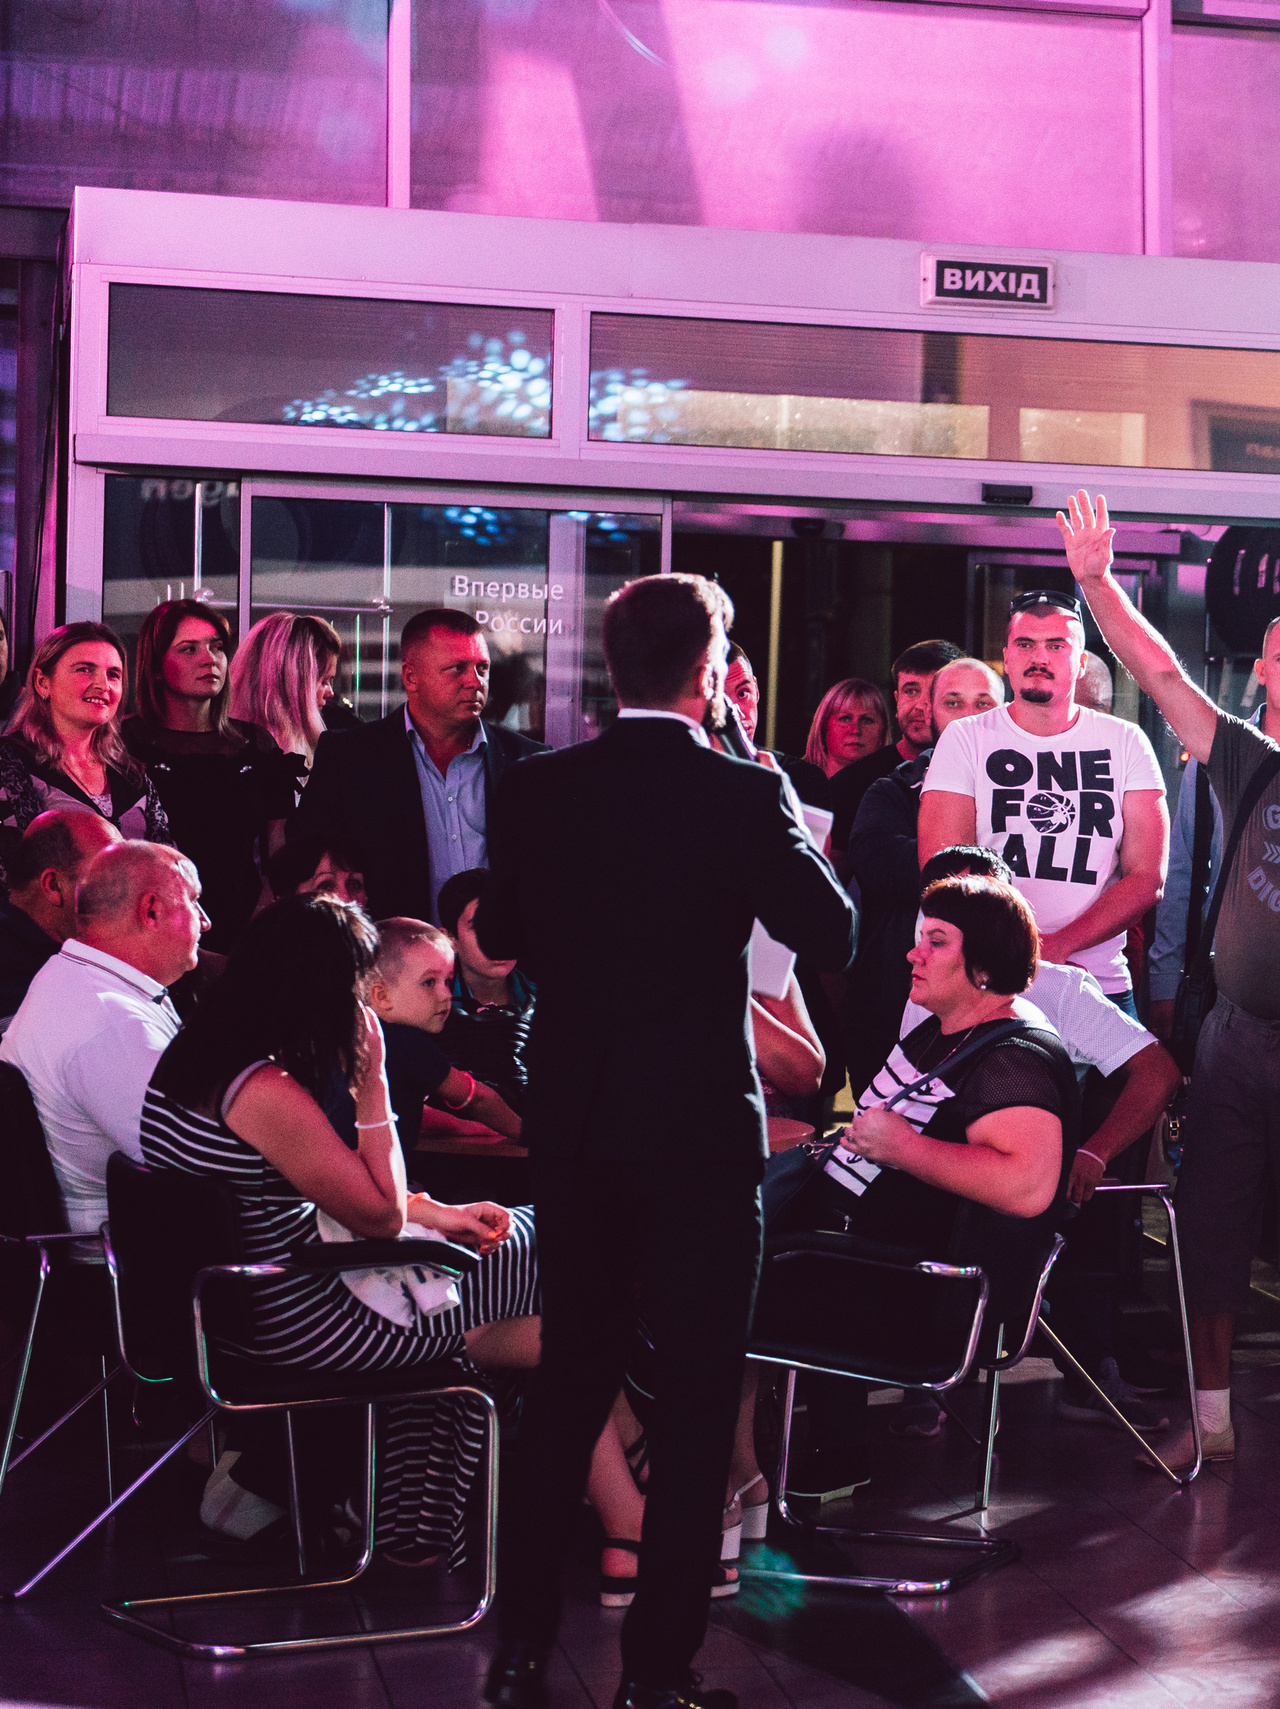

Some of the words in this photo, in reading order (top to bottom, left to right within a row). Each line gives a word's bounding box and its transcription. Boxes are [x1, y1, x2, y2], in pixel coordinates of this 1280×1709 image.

[943, 267, 1041, 299] ВИХІД
[454, 575, 563, 603] Впервые
[475, 610, 562, 634] России
[986, 748, 1115, 792] ONE
[1002, 833, 1098, 885] ALL
